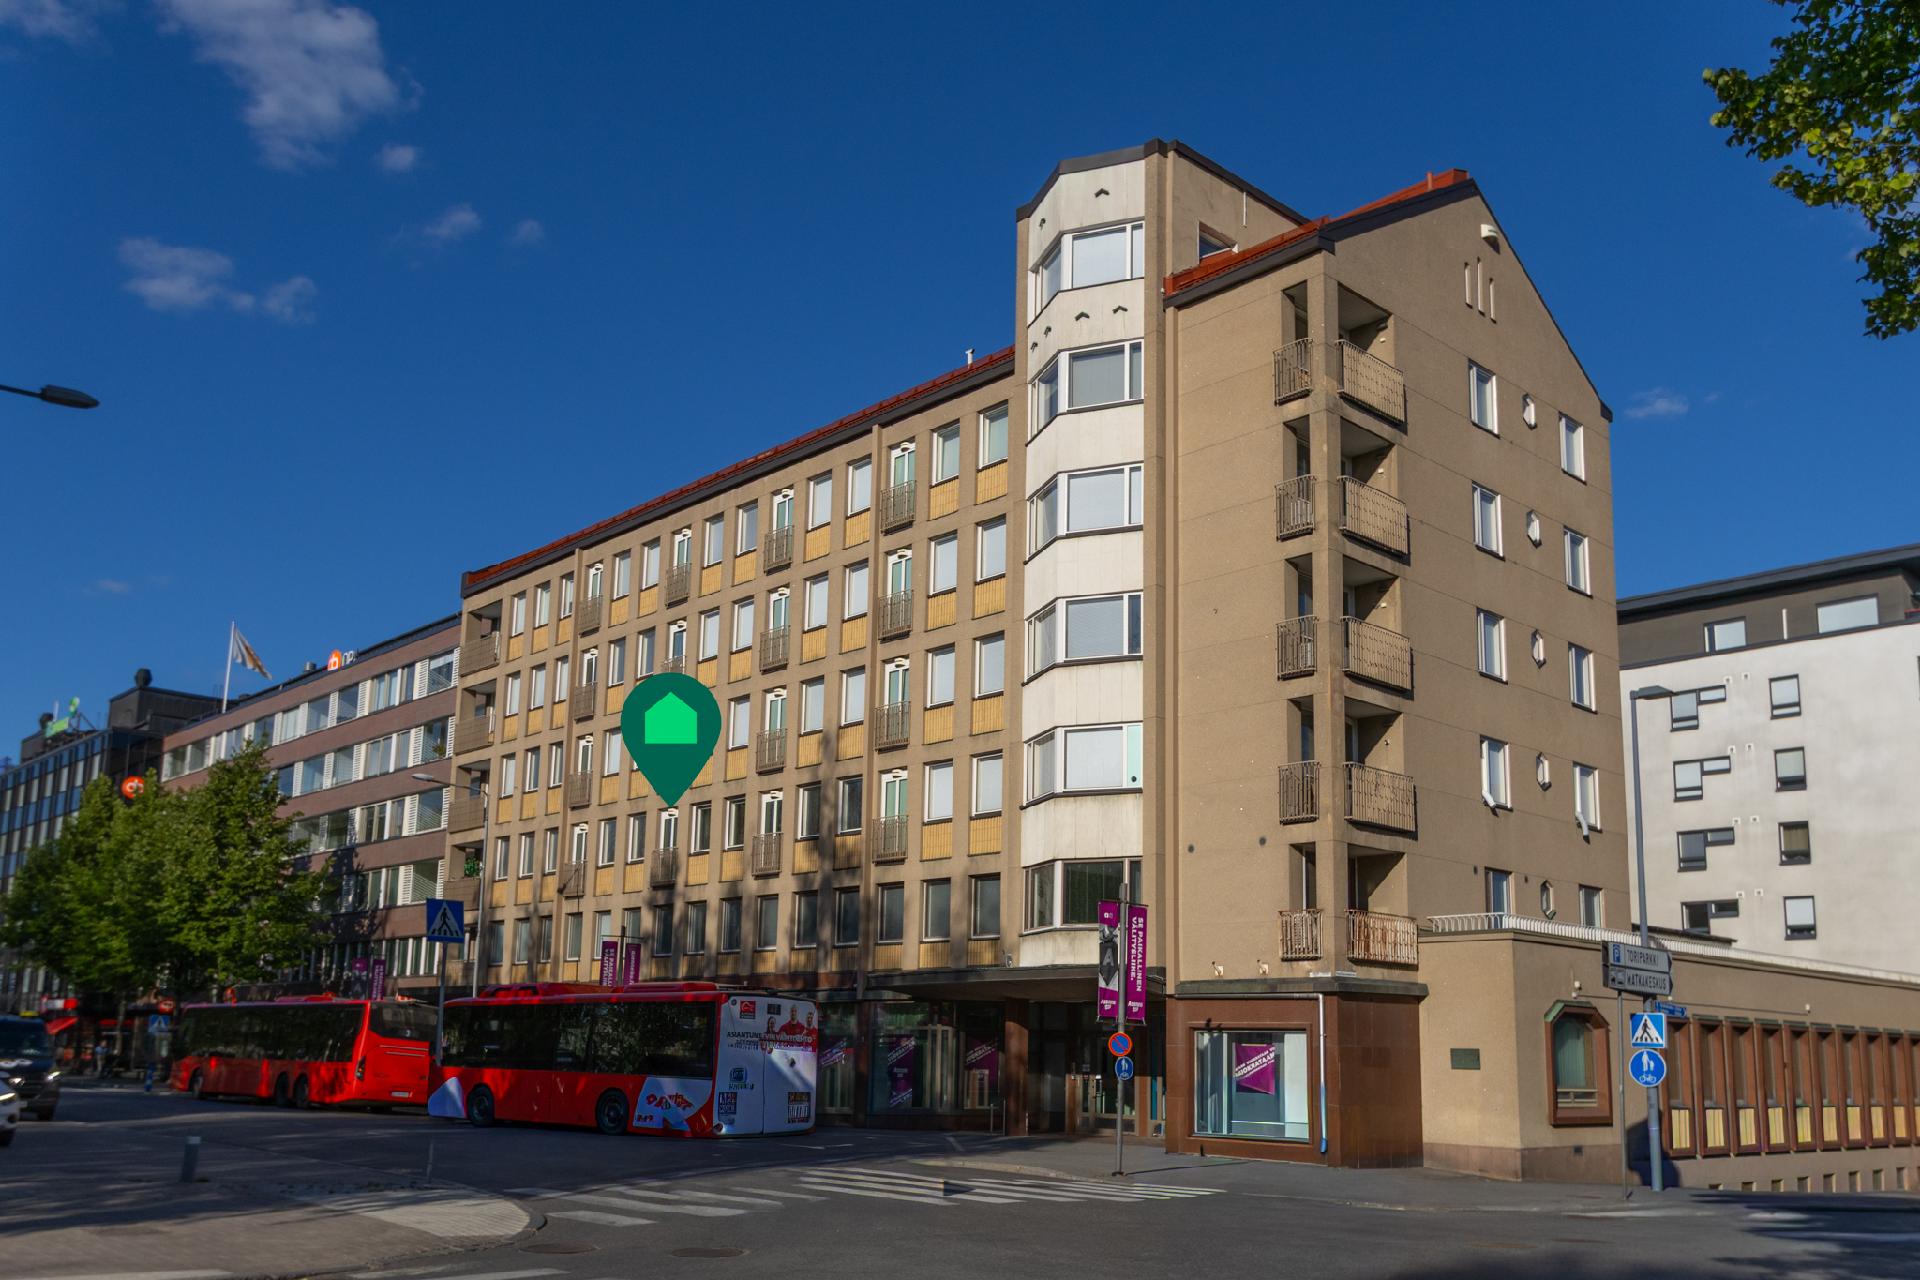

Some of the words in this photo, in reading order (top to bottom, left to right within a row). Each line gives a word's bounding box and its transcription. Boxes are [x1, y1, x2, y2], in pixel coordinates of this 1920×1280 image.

[1136, 930, 1144, 992] PAIKALLINEN
[1627, 949, 1659, 968] TORIPARKKI
[1627, 972, 1667, 991] MATKAKESKUS
